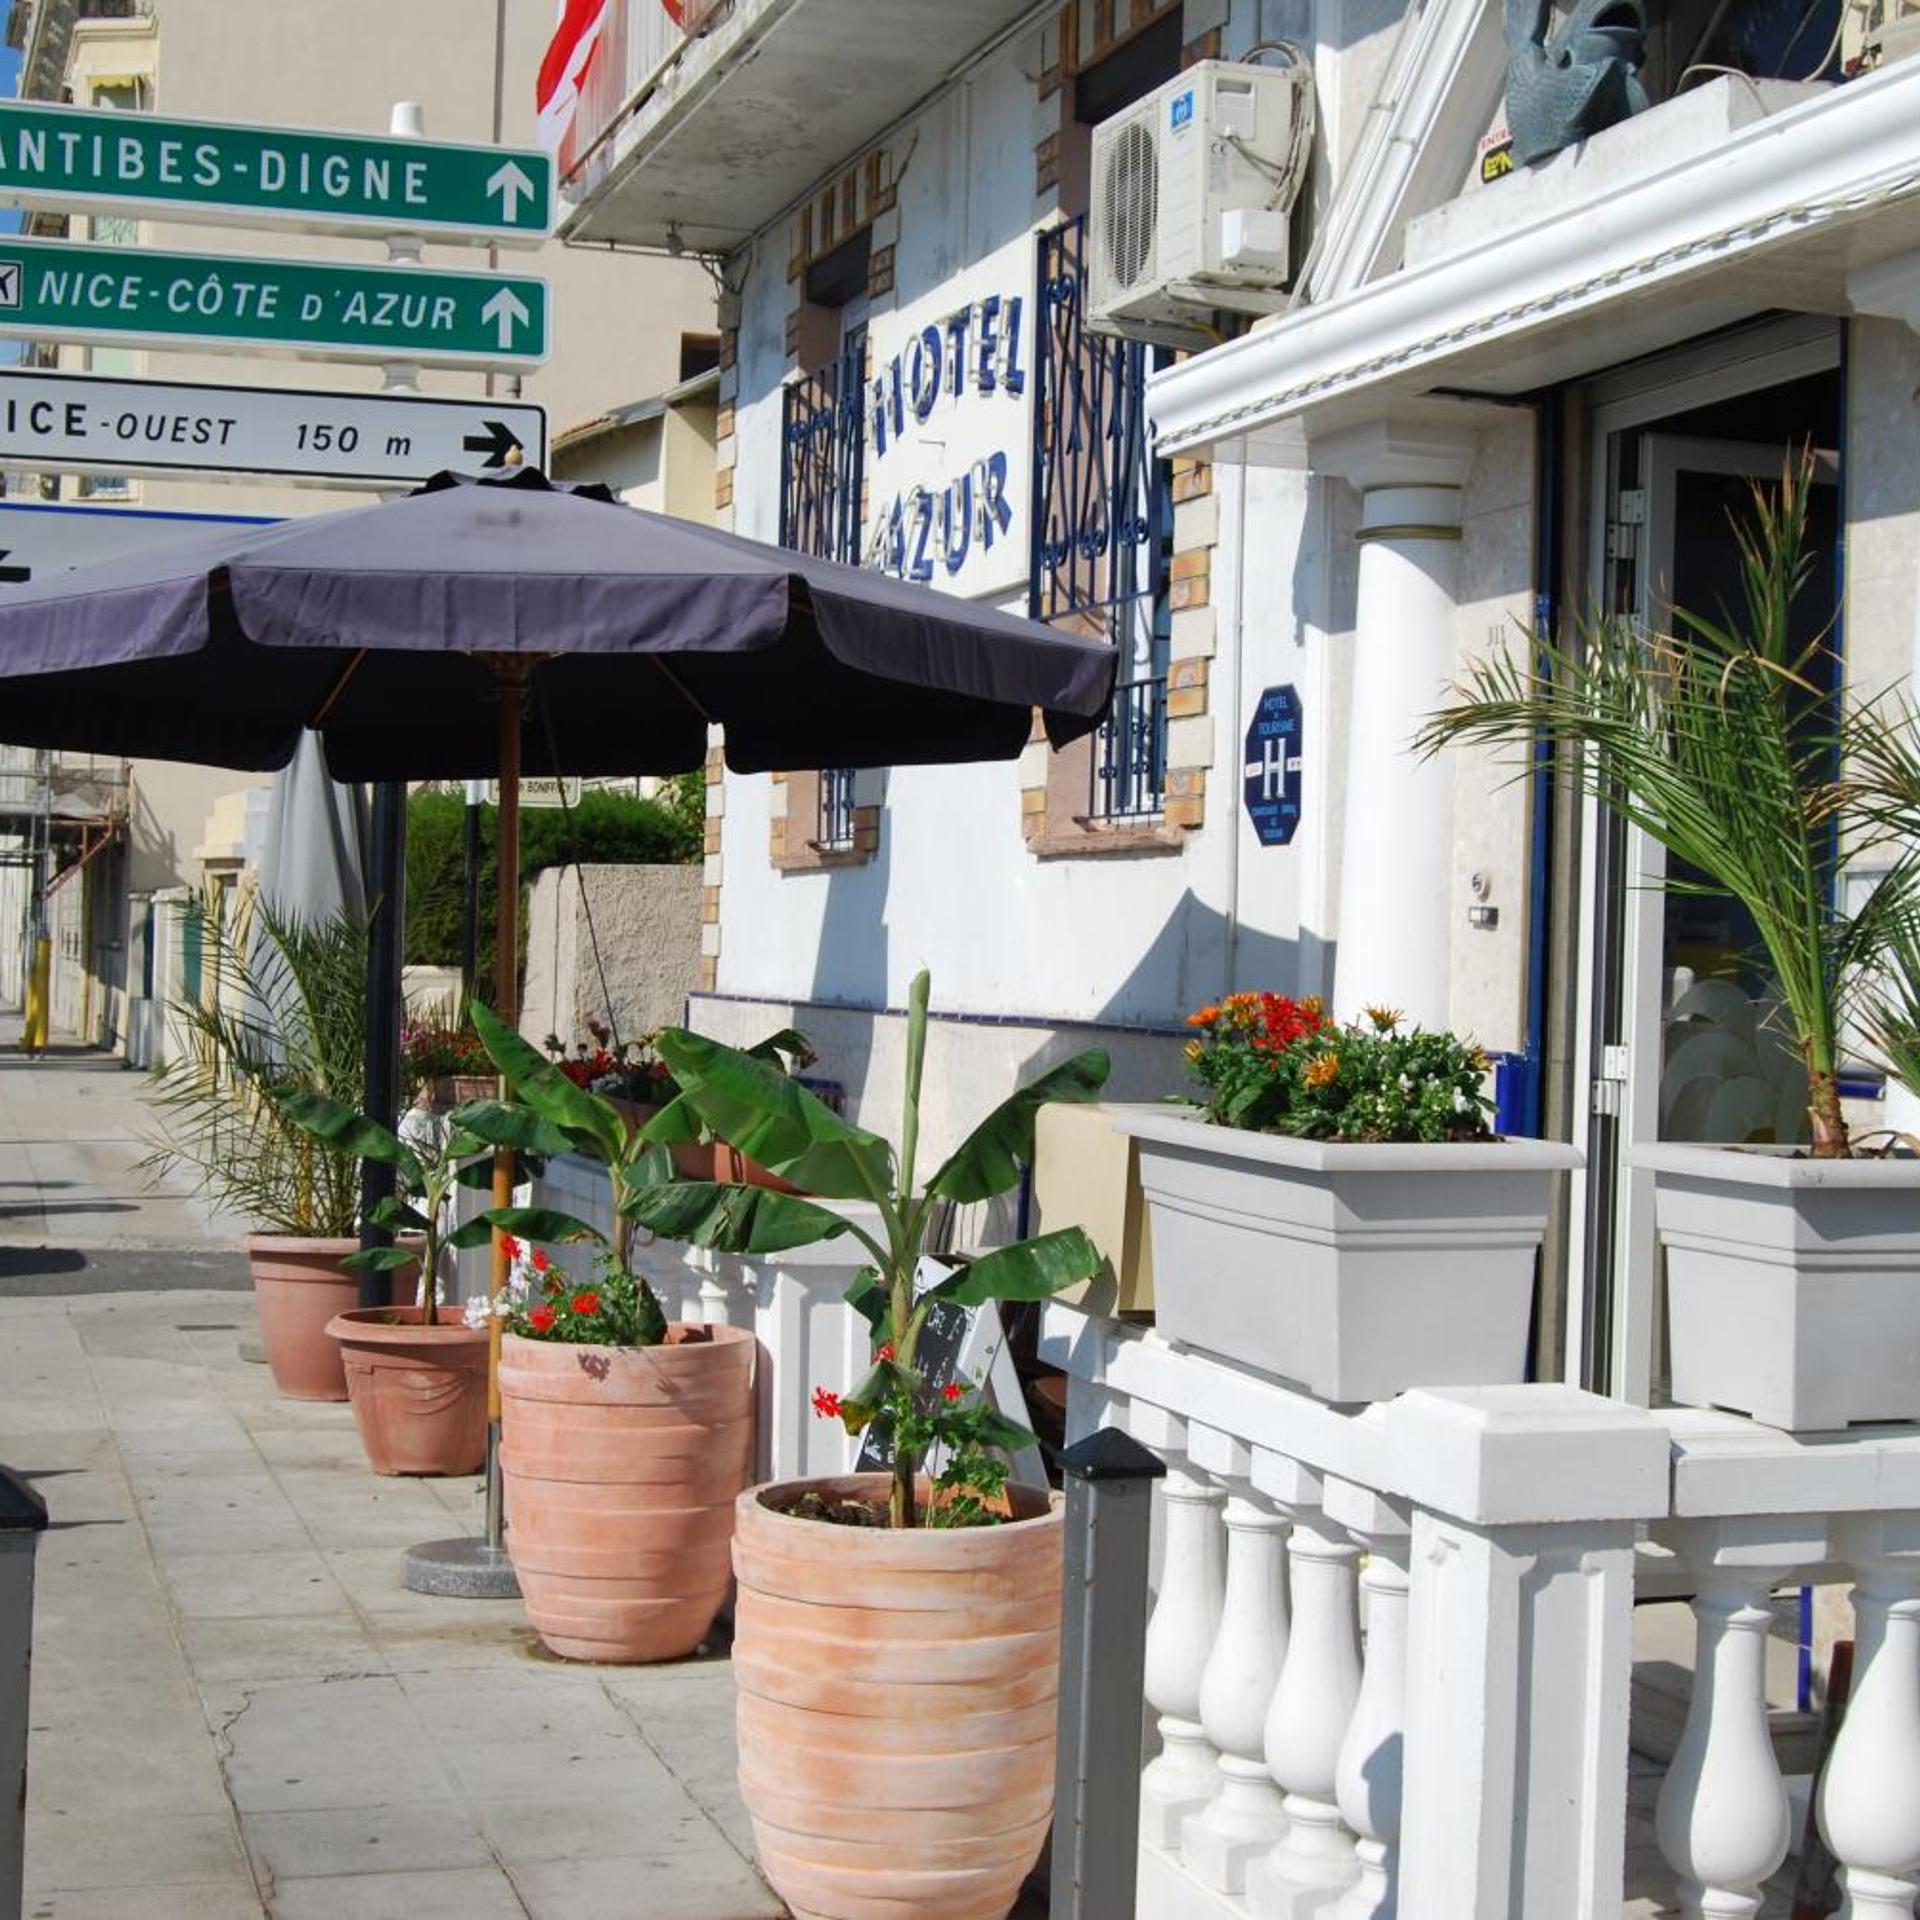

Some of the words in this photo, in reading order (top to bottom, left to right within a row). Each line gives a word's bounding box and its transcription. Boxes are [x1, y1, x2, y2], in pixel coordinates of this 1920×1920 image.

[0, 127, 428, 204] NTIBES-DIGNE
[38, 271, 280, 320] NICE-CÔTE
[868, 294, 1025, 459] HOTEL
[297, 423, 360, 453] 150
[386, 436, 412, 456] m
[864, 450, 1012, 581] AZUR
[1263, 737, 1287, 800] H
